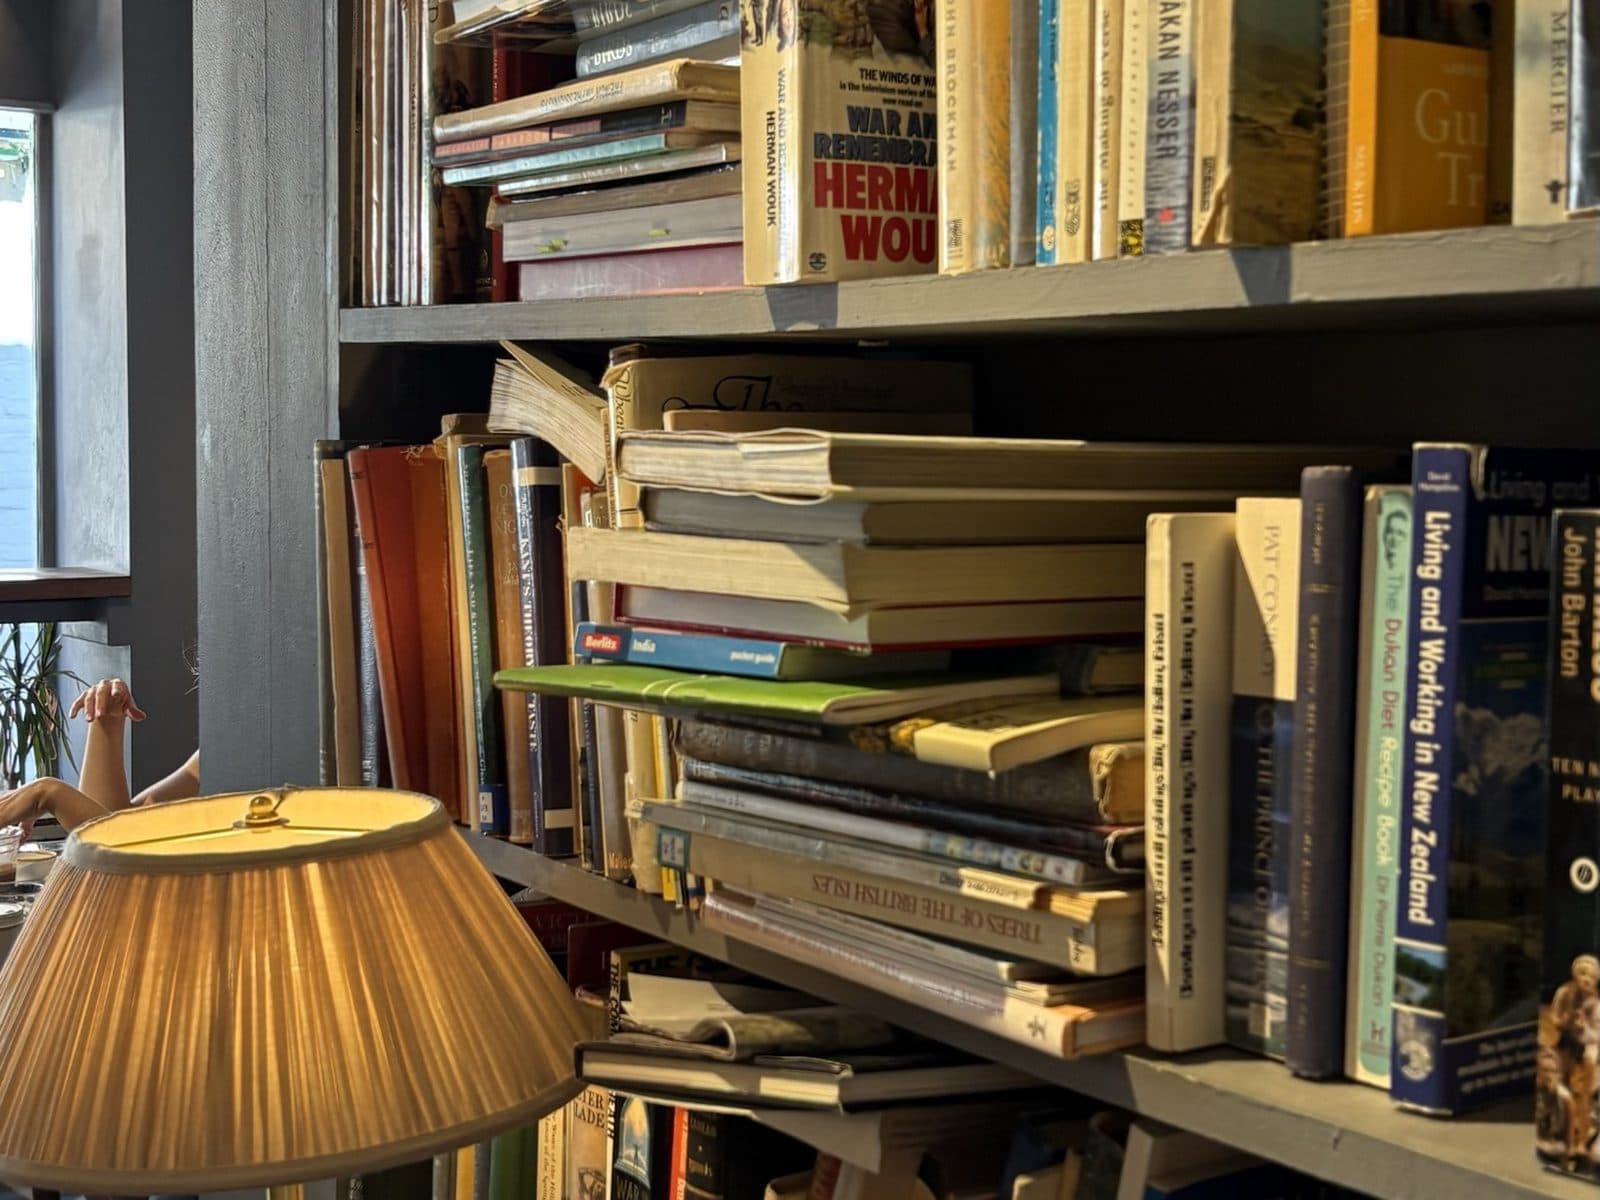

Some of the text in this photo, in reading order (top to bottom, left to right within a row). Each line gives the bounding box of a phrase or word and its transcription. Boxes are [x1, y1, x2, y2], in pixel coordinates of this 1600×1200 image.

[777, 68, 786, 104] WAR
[859, 68, 878, 80] THE
[879, 70, 909, 84] WINDS
[910, 74, 923, 85] OF
[1550, 11, 1568, 134] MERCIER
[777, 109, 787, 138] AND
[847, 105, 902, 136] WAR
[946, 48, 957, 172] BROCKMAN
[1155, 71, 1180, 159] NESSER
[765, 111, 777, 226] HERMAN WOUK
[1490, 471, 1590, 507] Living and
[1263, 526, 1281, 568] PAT
[1559, 527, 1588, 679] John Barton
[585, 635, 617, 650] Berlitz
[632, 638, 657, 653] India
[1383, 618, 1402, 683] Dukan
[527, 700, 538, 752] TASTE
[1381, 690, 1400, 730] Diet
[1408, 511, 1451, 926] Living and Working in New Zealand
[1376, 735, 1399, 809] Recipe
[1551, 756, 1585, 776] TEN
[1376, 814, 1396, 867] Book
[812, 873, 1042, 944] TREES OF THE BRITISH ISLES
